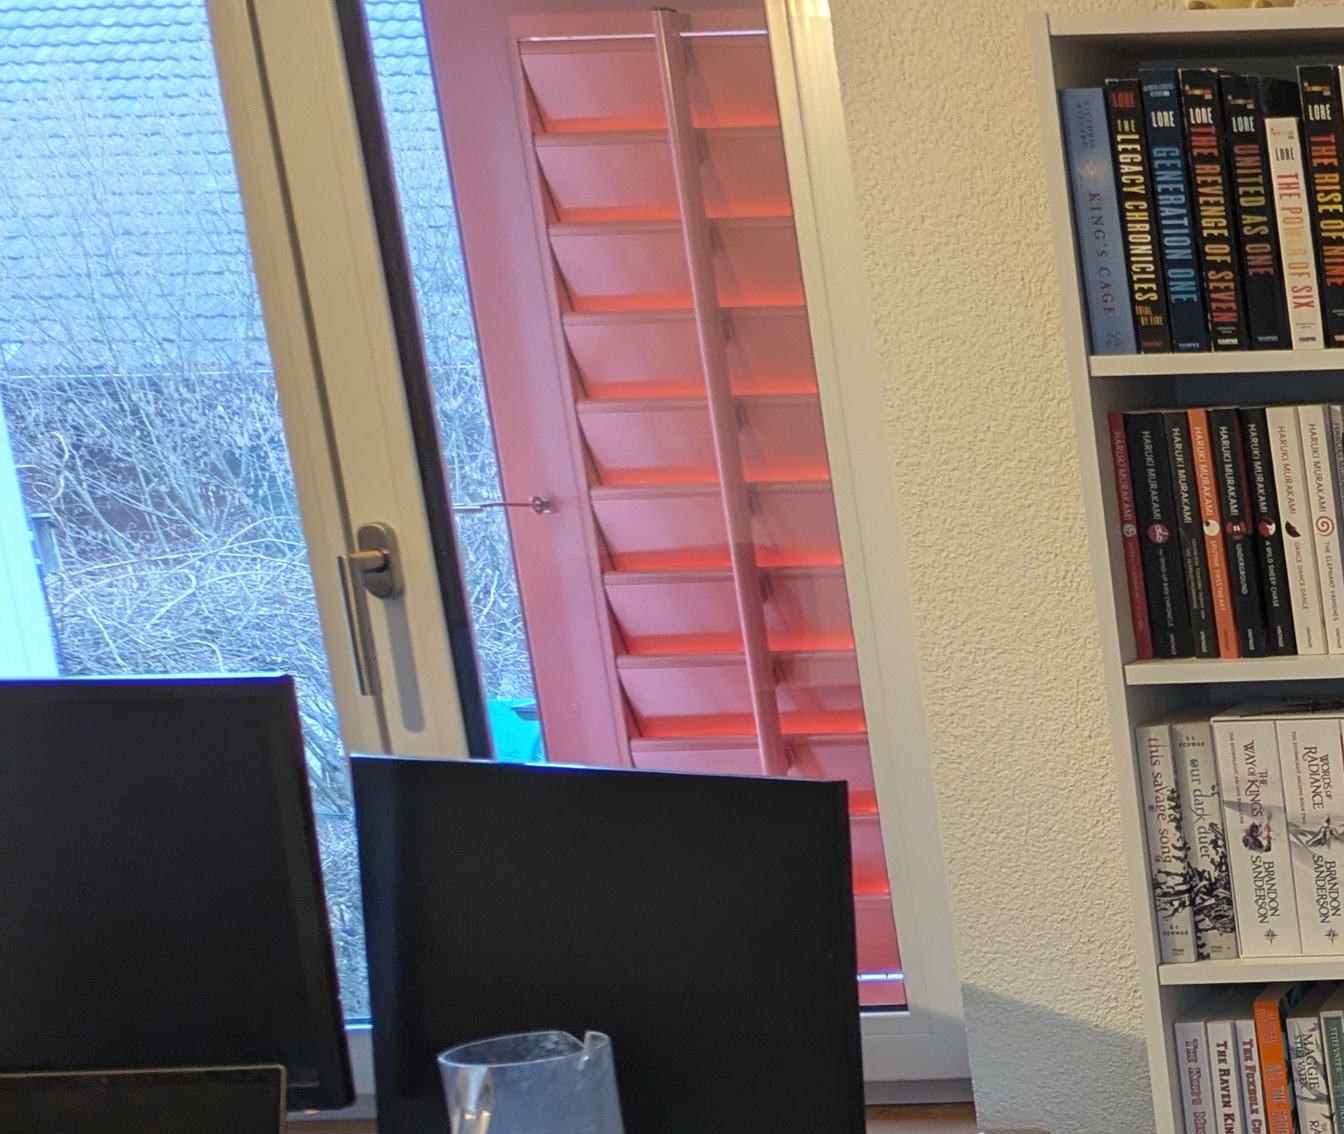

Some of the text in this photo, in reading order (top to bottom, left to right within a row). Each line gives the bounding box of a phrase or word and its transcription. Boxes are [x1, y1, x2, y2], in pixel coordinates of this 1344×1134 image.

[1189, 107, 1213, 124] LORE
[1308, 104, 1331, 120] LORE
[1117, 134, 1146, 194] LEGACY
[1190, 126, 1218, 156] THE
[1310, 135, 1337, 166] THE
[1195, 163, 1228, 238] REVENGE
[1314, 173, 1343, 213] RISE
[1152, 147, 1197, 303] GENERATION ONE
[1126, 201, 1157, 302] CHRONICLES
[1205, 242, 1231, 266] OF
[1208, 271, 1237, 322] SEVEN
[1220, 426, 1238, 516] HARUKI MURAKAMI
[1308, 423, 1327, 512] HARUKI MURAKAMI
